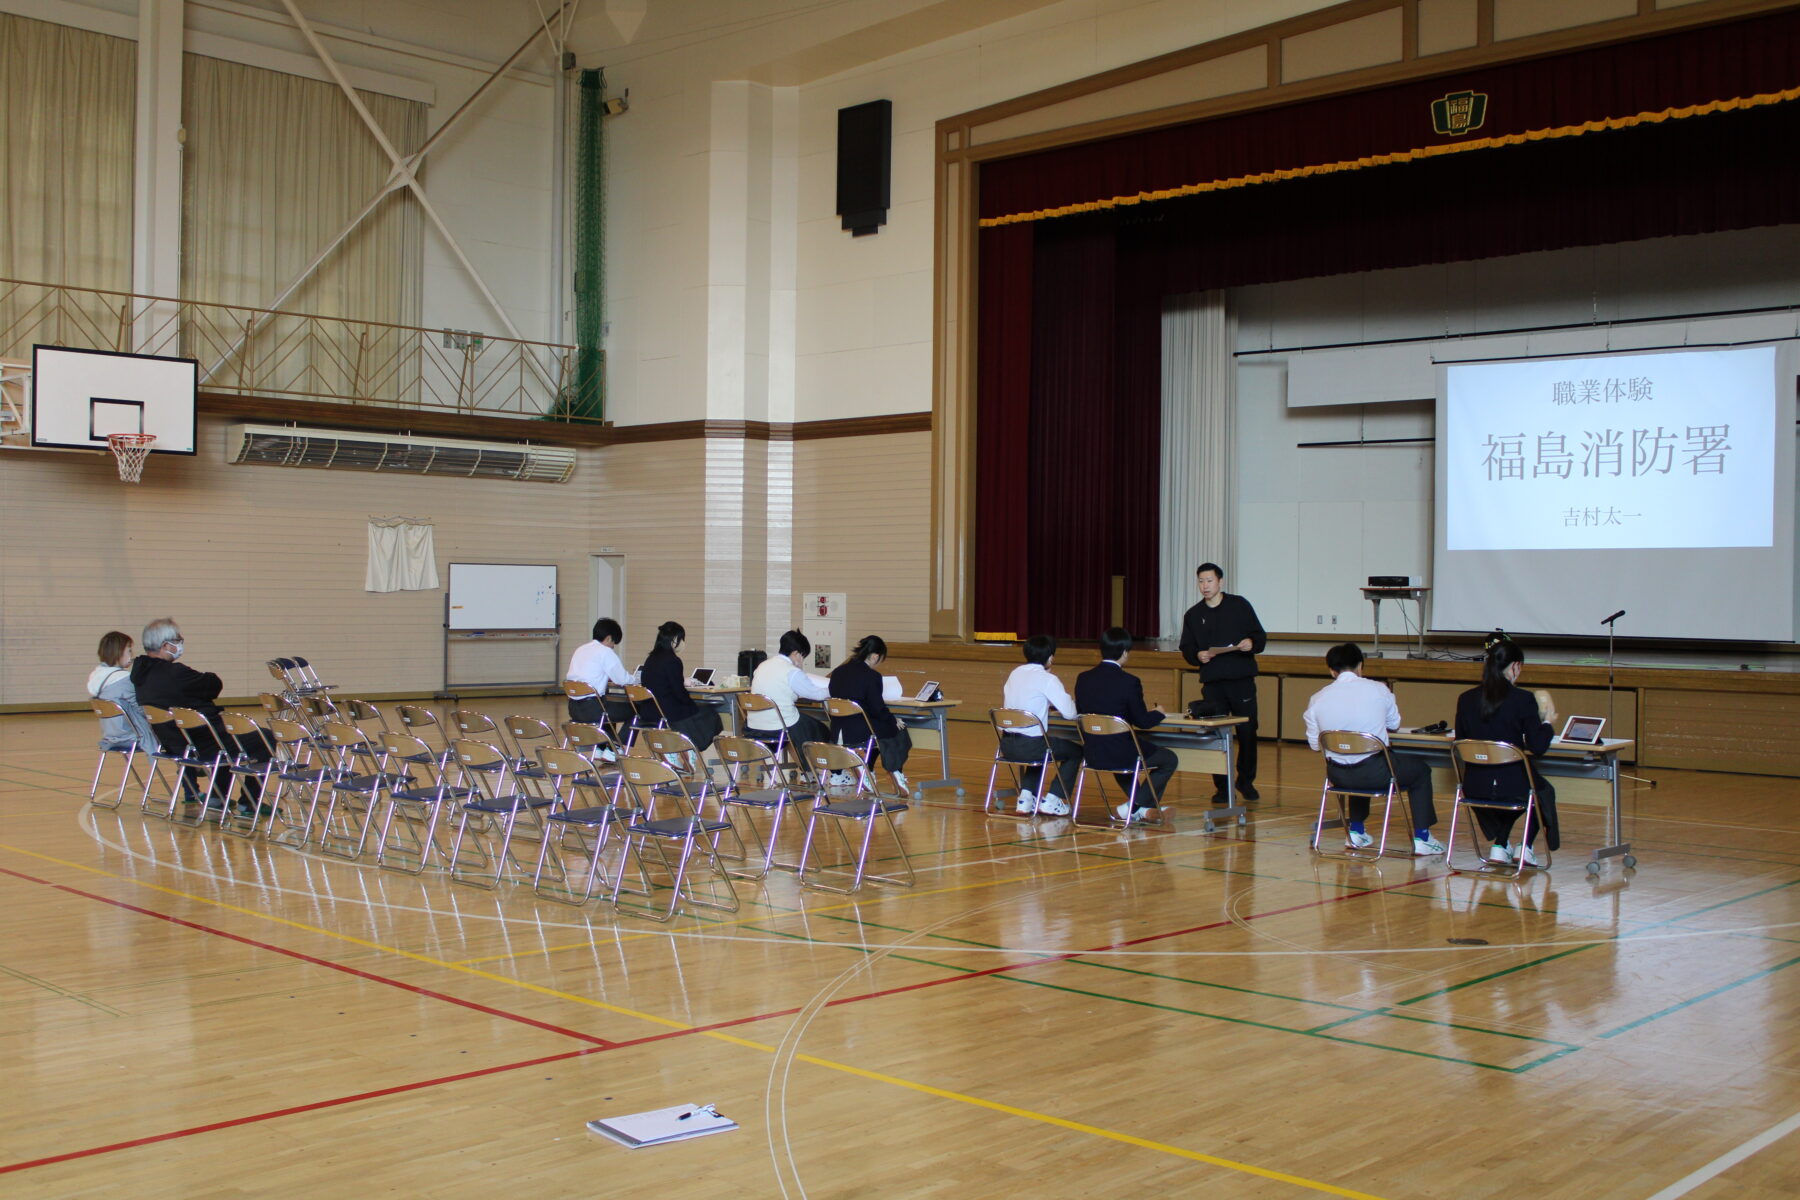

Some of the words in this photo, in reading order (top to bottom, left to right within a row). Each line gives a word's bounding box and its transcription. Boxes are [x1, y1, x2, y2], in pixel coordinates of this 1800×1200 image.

[1552, 376, 1654, 406] 職業体験
[1482, 425, 1732, 481] 福島消防署
[1563, 506, 1642, 527] 吉村太一
